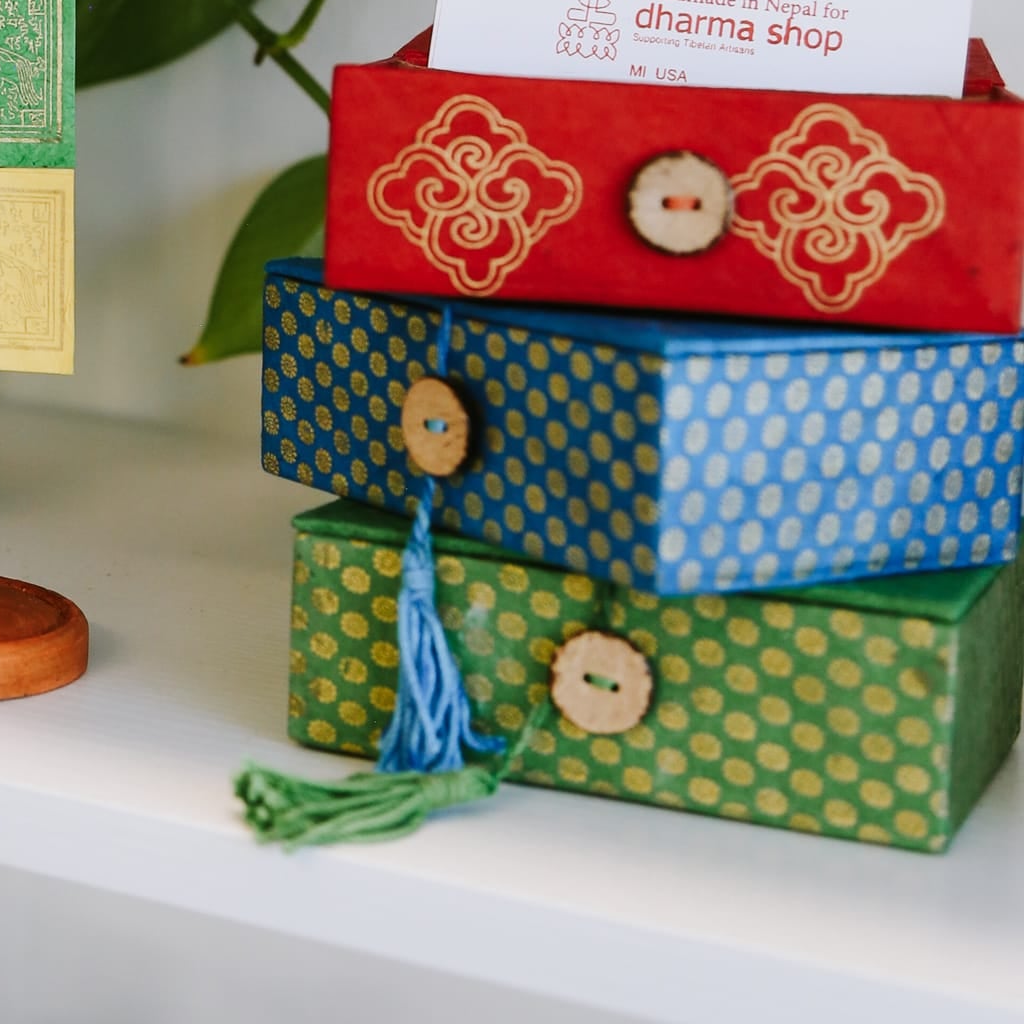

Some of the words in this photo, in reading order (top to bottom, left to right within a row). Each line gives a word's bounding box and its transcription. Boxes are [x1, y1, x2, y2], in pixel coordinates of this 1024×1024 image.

[822, 2, 849, 20] for
[635, 2, 755, 42] dharma
[767, 17, 843, 57] shop
[632, 32, 681, 48] Supporting
[629, 64, 647, 78] MI
[655, 67, 688, 83] USA
